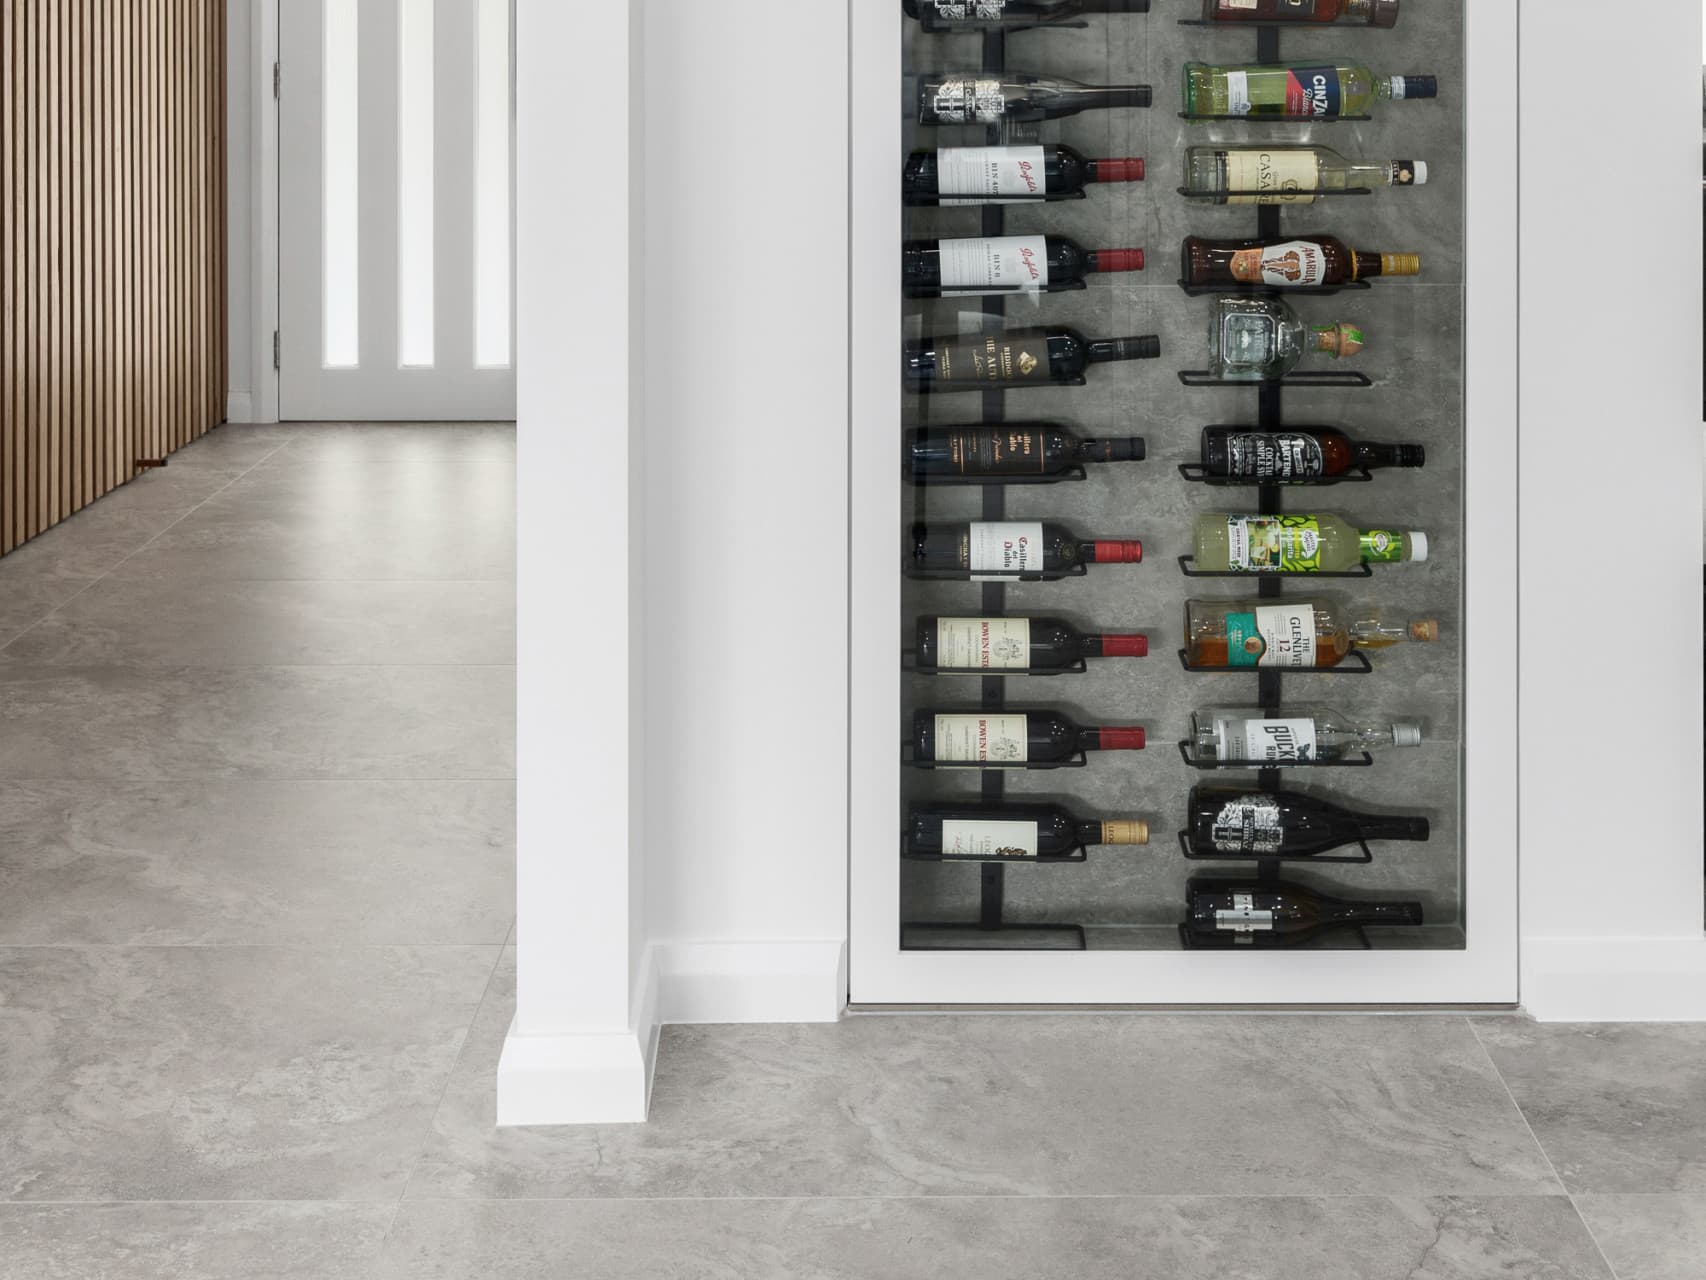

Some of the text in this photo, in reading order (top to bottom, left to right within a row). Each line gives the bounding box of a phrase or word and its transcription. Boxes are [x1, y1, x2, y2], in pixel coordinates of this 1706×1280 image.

[1313, 75, 1328, 116] CINZA
[1259, 153, 1271, 190] CASA
[1302, 246, 1317, 285] AMARULA
[1004, 541, 1013, 568] Diablo
[981, 622, 989, 668] BOWEN ESTA
[1279, 639, 1291, 652] 12
[1302, 637, 1310, 653] THE
[979, 720, 987, 749] BOWEN
